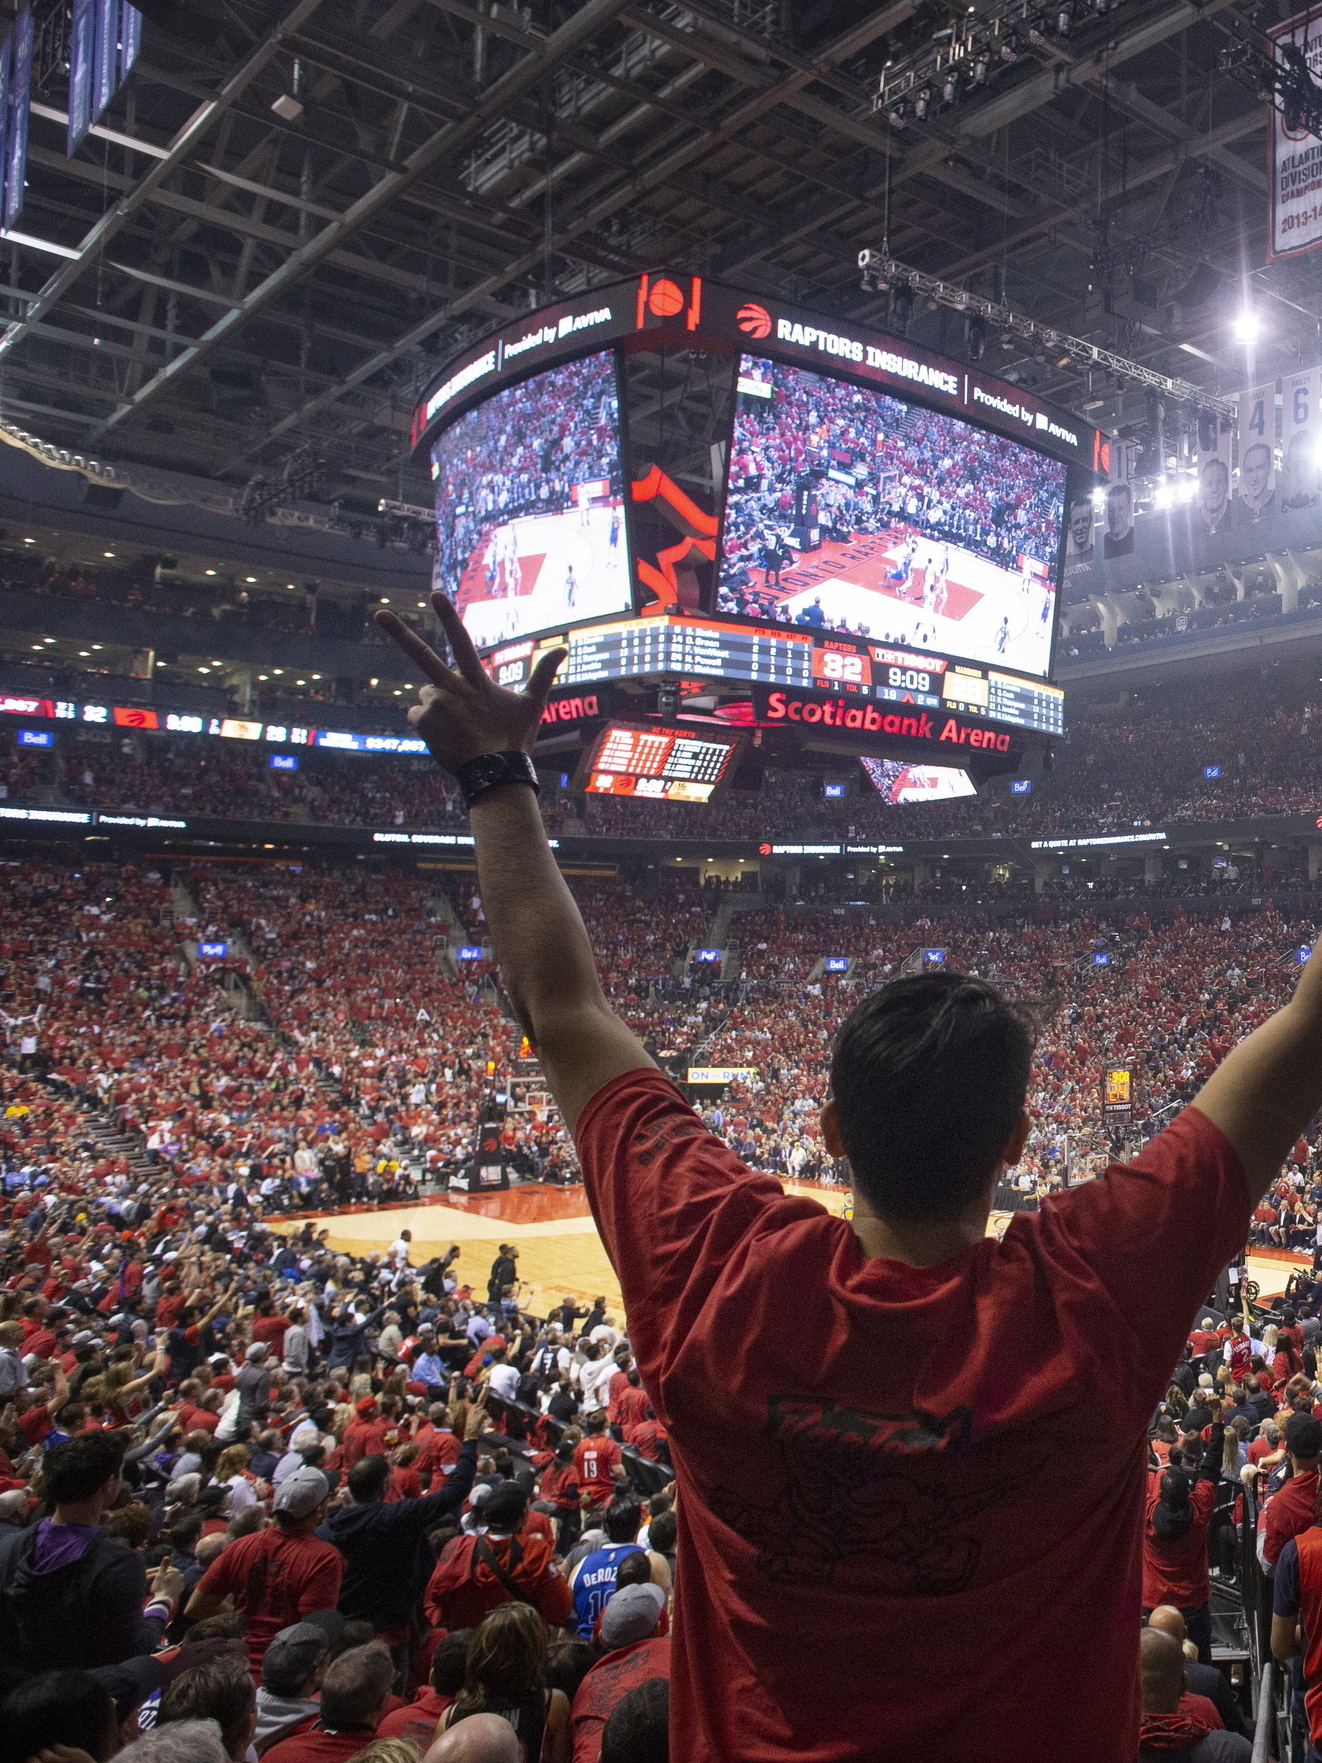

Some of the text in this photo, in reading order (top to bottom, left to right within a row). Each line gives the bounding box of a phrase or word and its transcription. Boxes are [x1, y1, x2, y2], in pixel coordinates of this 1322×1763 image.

[543, 326, 557, 343] by
[572, 308, 612, 331] AVIVA
[777, 318, 863, 362] RAPTORS
[865, 347, 958, 395] INSURANCE
[973, 387, 1020, 418] Provided
[1020, 408, 1034, 426] by
[1048, 422, 1078, 447] AVIVA
[1293, 387, 1309, 425] 6
[1249, 401, 1265, 436] 4
[824, 640, 857, 653] RAPTORS
[823, 652, 862, 682] 32
[896, 653, 944, 672] TISSOT
[499, 661, 524, 685] 9:09
[889, 667, 930, 692] 9:09
[816, 680, 829, 688] FLS
[833, 681, 840, 691] 1
[917, 695, 924, 704] 2
[539, 694, 599, 724] Arena
[766, 692, 1011, 751] Scotiabank Arena
[23, 733, 48, 744] Bell
[274, 757, 294, 768] Bell
[826, 786, 840, 796] Bell
[1031, 841, 1043, 849] GET
[1049, 839, 1068, 848] QUOTE
[830, 960, 844, 969] Bell
[691, 1071, 709, 1081] ON
[1112, 1071, 1130, 1082] 9:08
[1241, 1349, 1249, 1362] 2
[584, 1460, 598, 1479] 19
